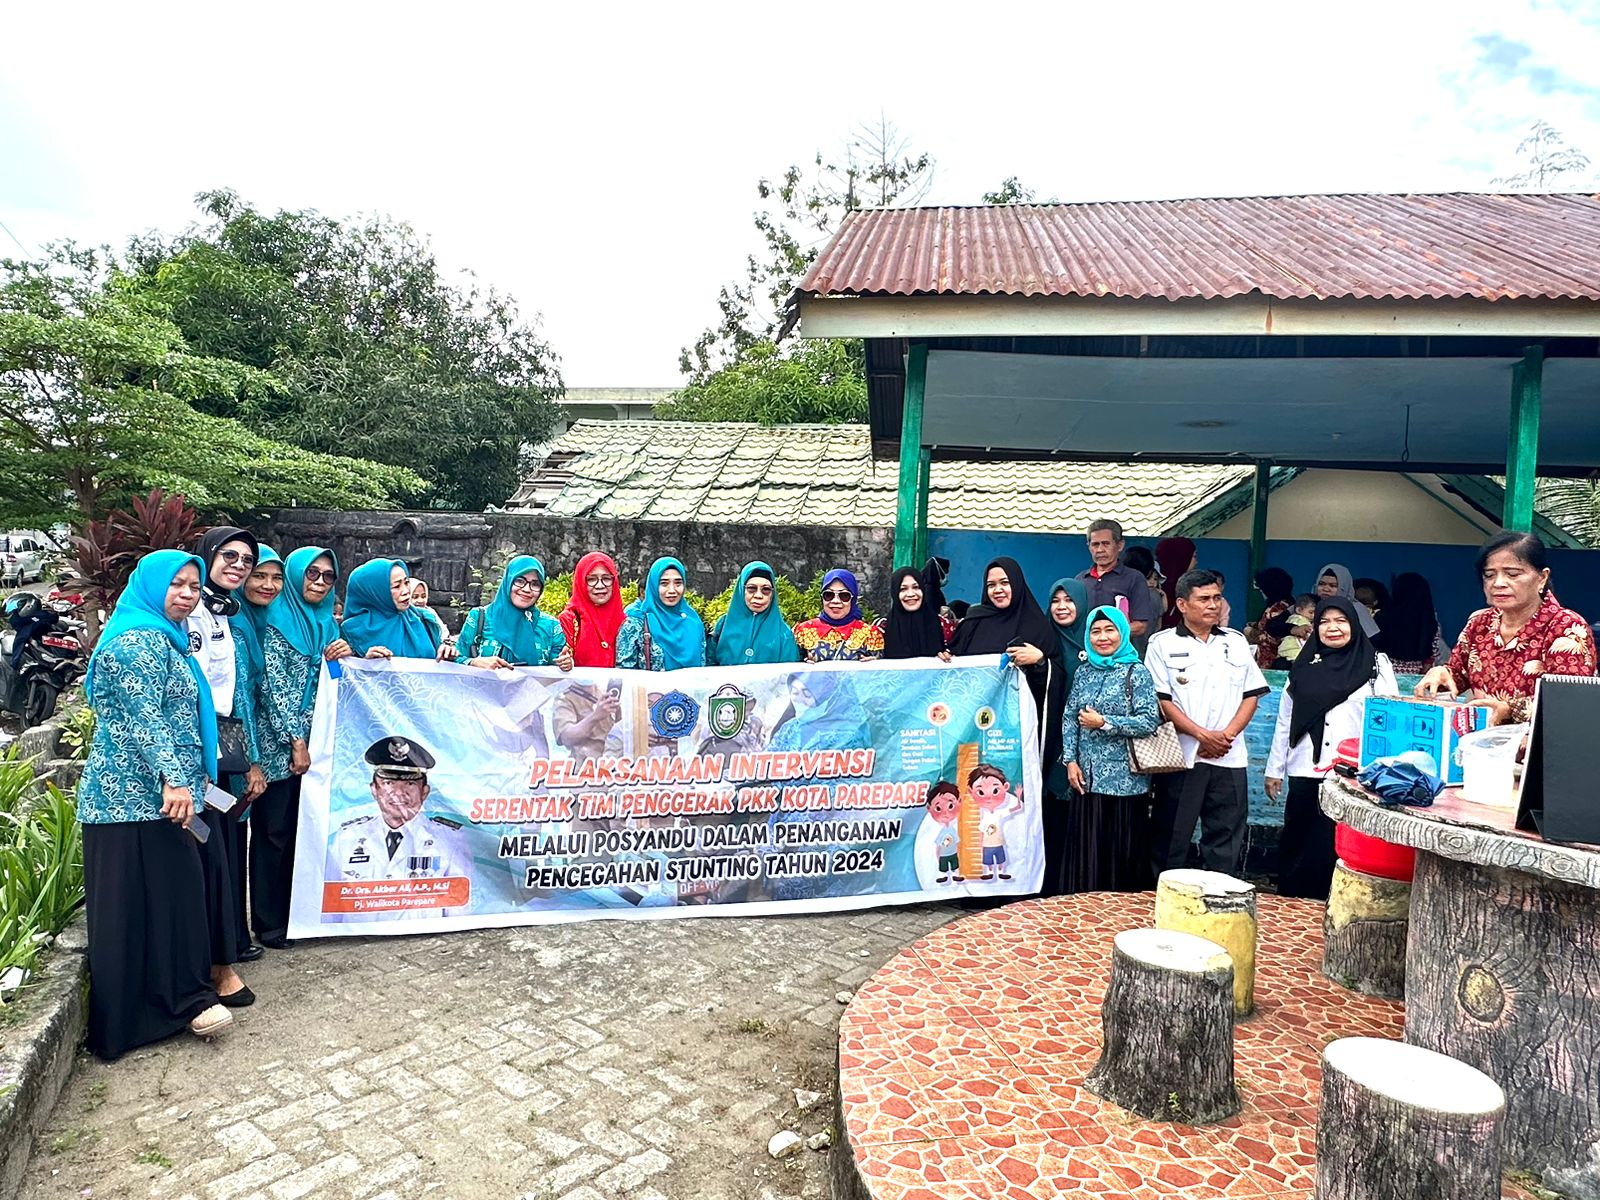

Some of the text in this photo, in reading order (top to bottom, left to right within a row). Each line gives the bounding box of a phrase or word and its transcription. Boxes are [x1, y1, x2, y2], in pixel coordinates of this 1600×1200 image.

[530, 750, 874, 786] PELAKSANAAN INTERVENSI
[470, 782, 928, 822] SERENTAK TIM PENGGERAK PKK KOTA PAREPARE
[500, 820, 901, 857] MELALUI POSYANDU DALAM PENANGANAN
[526, 850, 883, 887] PENCEGAHAN STUNTING TAHUN 2024
